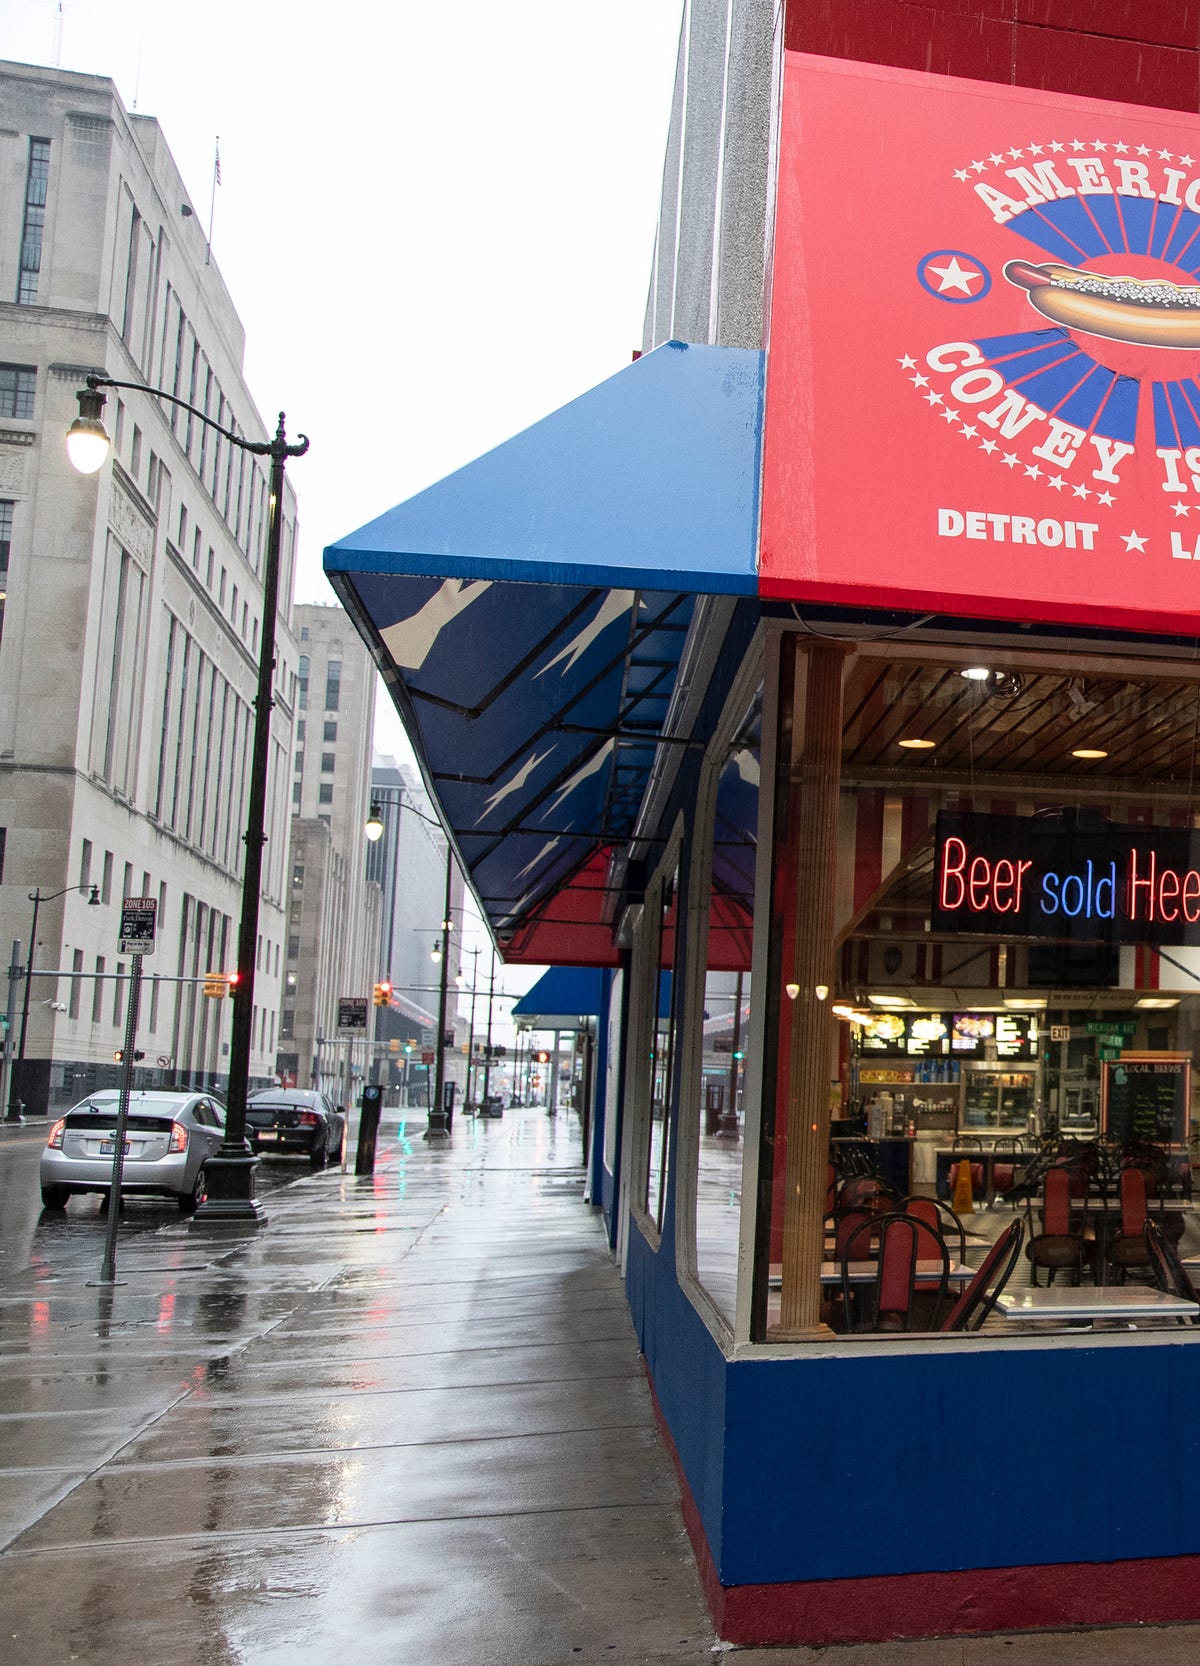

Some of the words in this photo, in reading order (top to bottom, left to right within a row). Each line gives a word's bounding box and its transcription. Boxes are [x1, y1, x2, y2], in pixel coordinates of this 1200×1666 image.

[925, 341, 1136, 485] CONEY
[938, 508, 1099, 551] DETROIT
[942, 837, 1033, 912] Beer
[1040, 859, 1116, 919] sold
[124, 899, 141, 909] ZONE
[142, 899, 155, 909] 105
[1052, 1028, 1068, 1039] EXIT
[1125, 1065, 1150, 1073] LOCAL
[1154, 1065, 1182, 1073] BREWS
